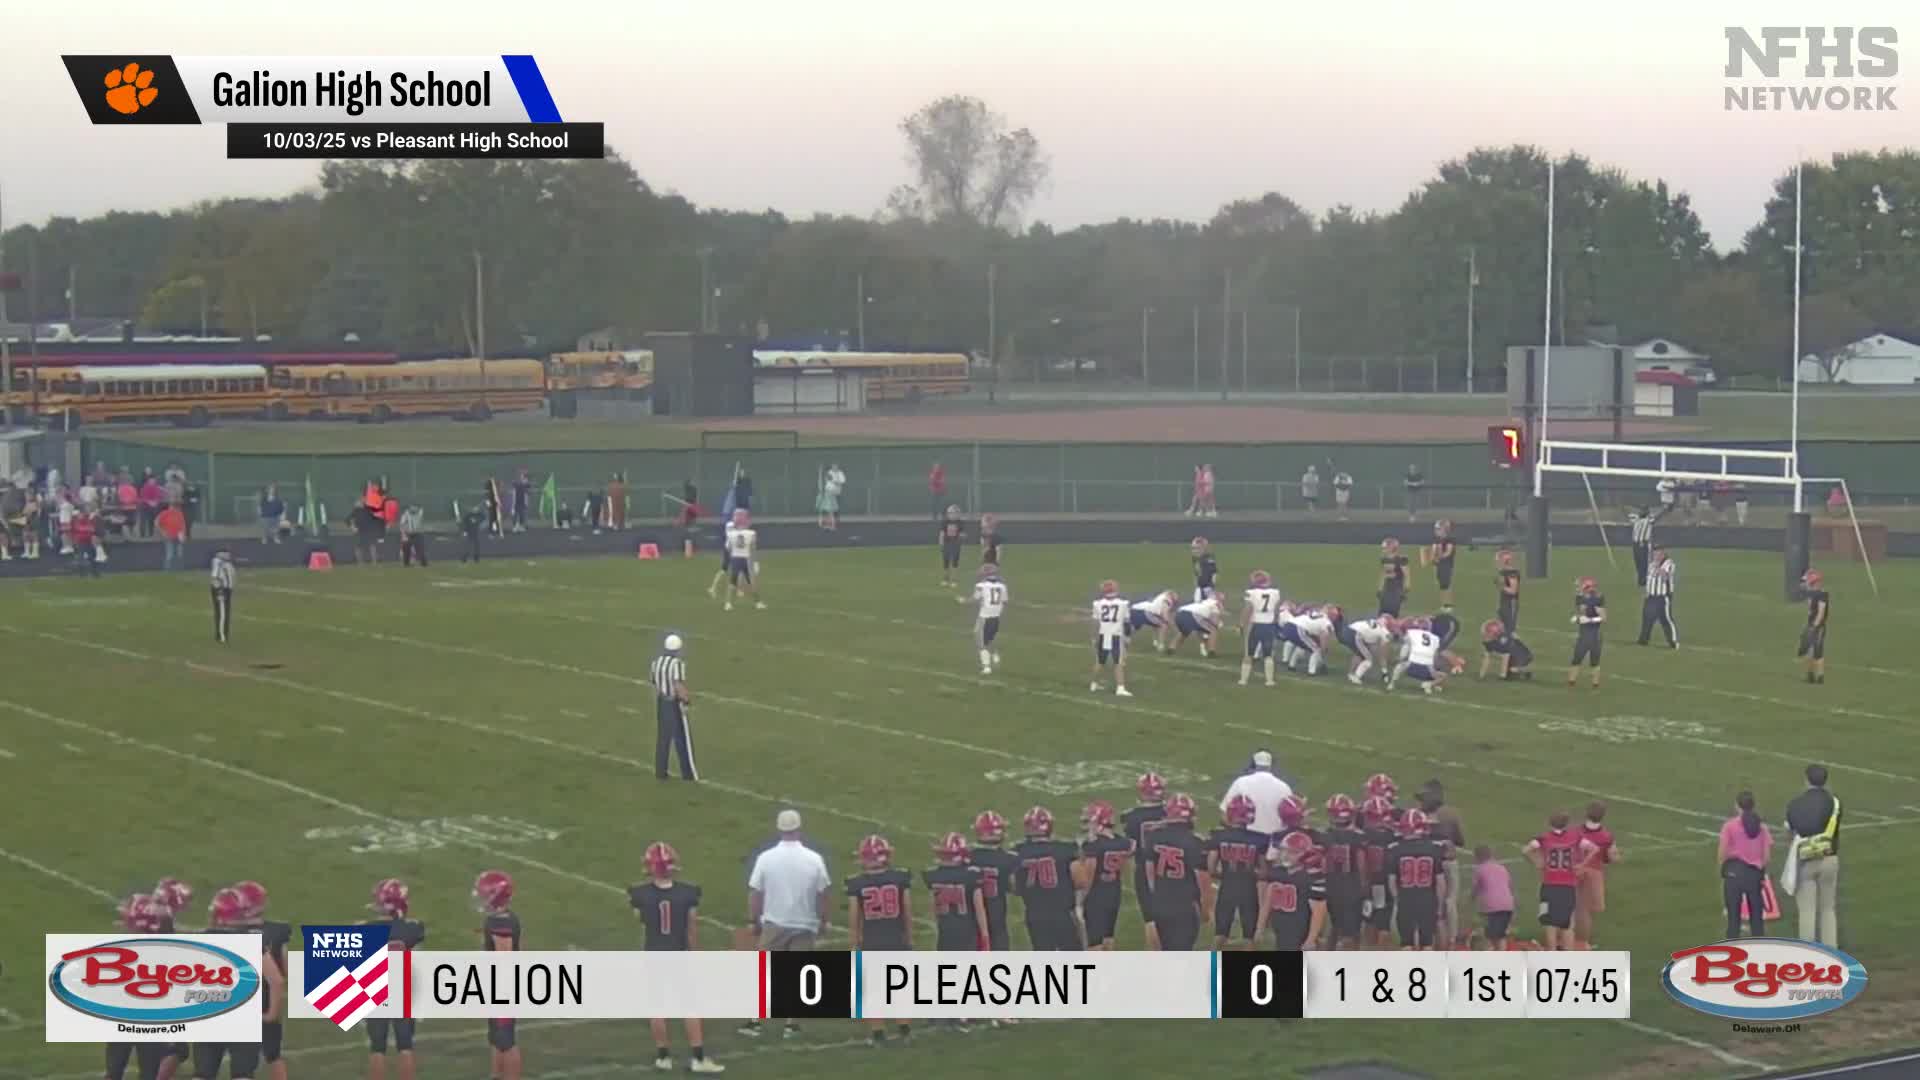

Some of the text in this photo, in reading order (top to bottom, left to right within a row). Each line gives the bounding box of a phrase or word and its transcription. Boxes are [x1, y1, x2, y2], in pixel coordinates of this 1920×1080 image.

[1100, 604, 1119, 622] 27
[1261, 594, 1270, 613] 7
[1022, 856, 1058, 888] 70
[1153, 844, 1185, 879] 75
[659, 900, 671, 935] 1
[862, 884, 899, 919] 28
